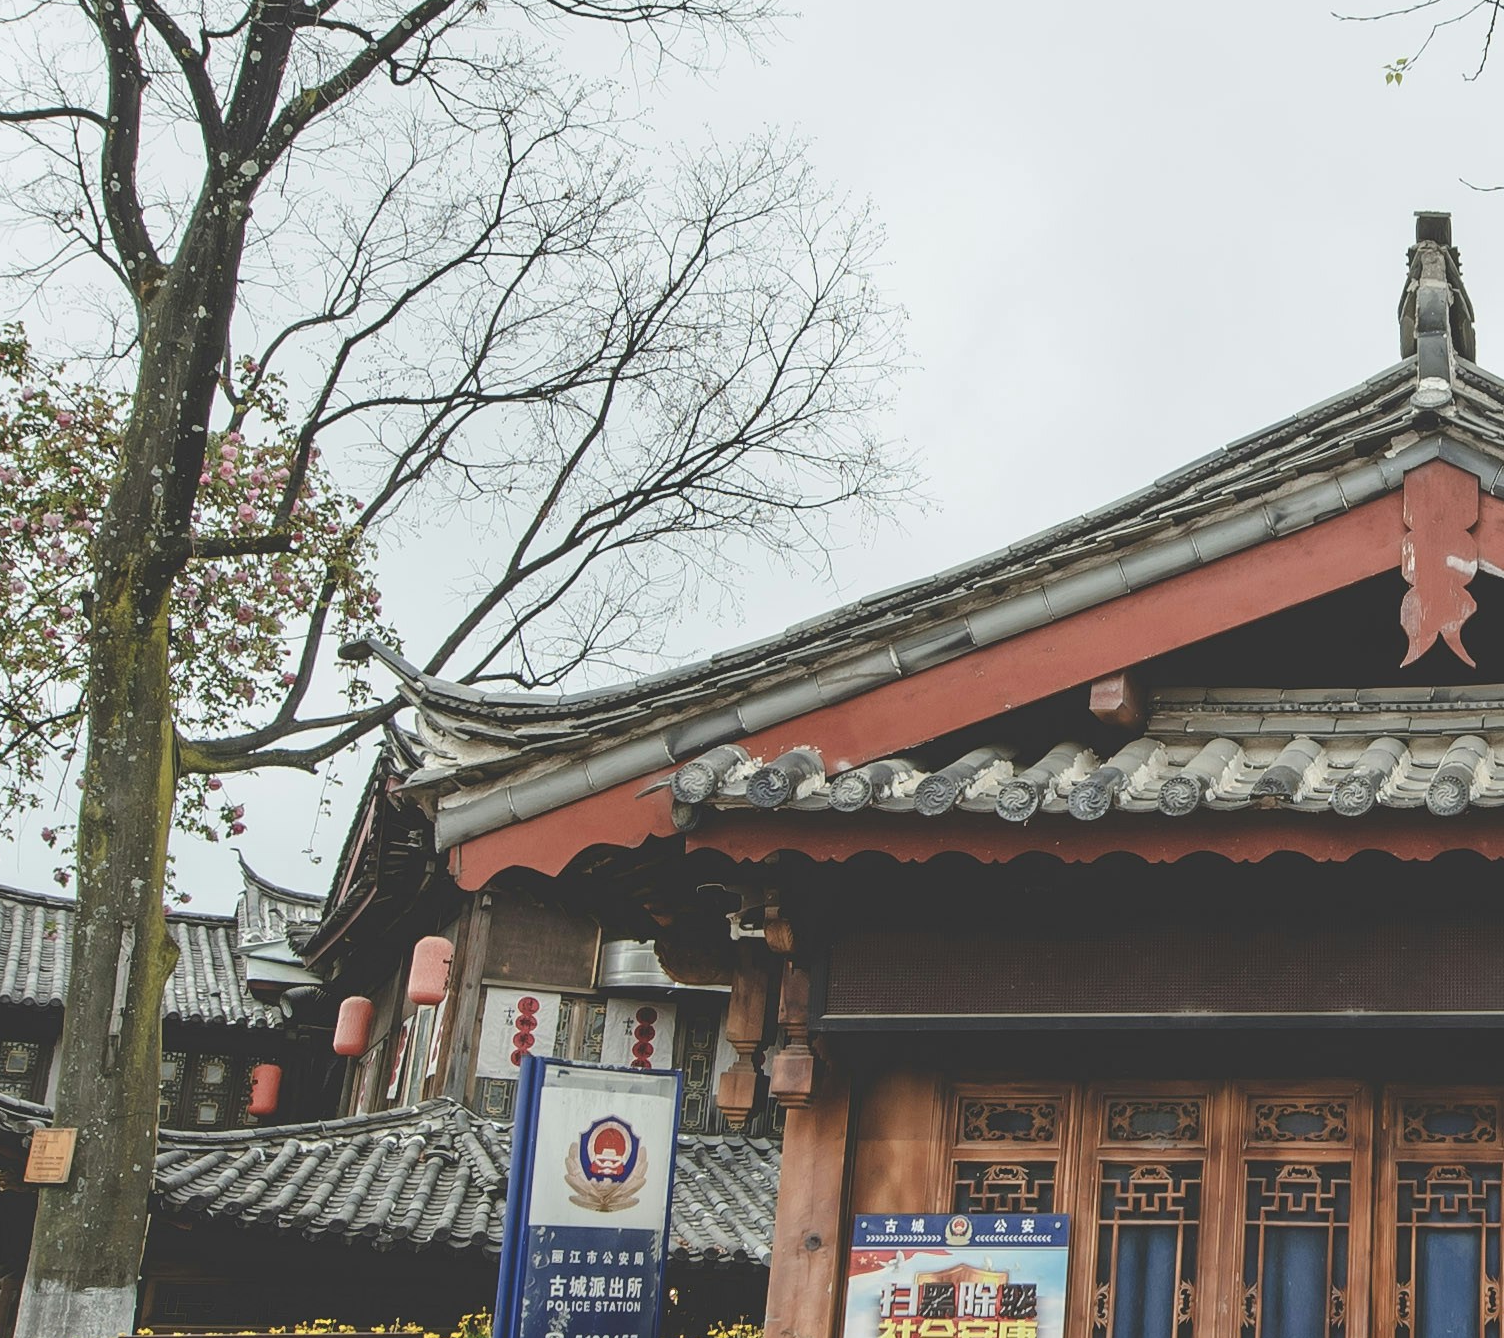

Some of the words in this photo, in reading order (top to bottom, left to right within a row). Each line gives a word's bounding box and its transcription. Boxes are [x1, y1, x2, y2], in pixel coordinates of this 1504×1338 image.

[884, 1217, 926, 1233] 古城
[993, 1217, 1036, 1233] 公安
[551, 1249, 645, 1266] 丽江市公安局
[549, 1274, 643, 1298] 古城派出所
[546, 1300, 591, 1312] POLICE
[594, 1301, 641, 1312] STATION
[879, 1281, 1039, 1318] 扫黑除恶
